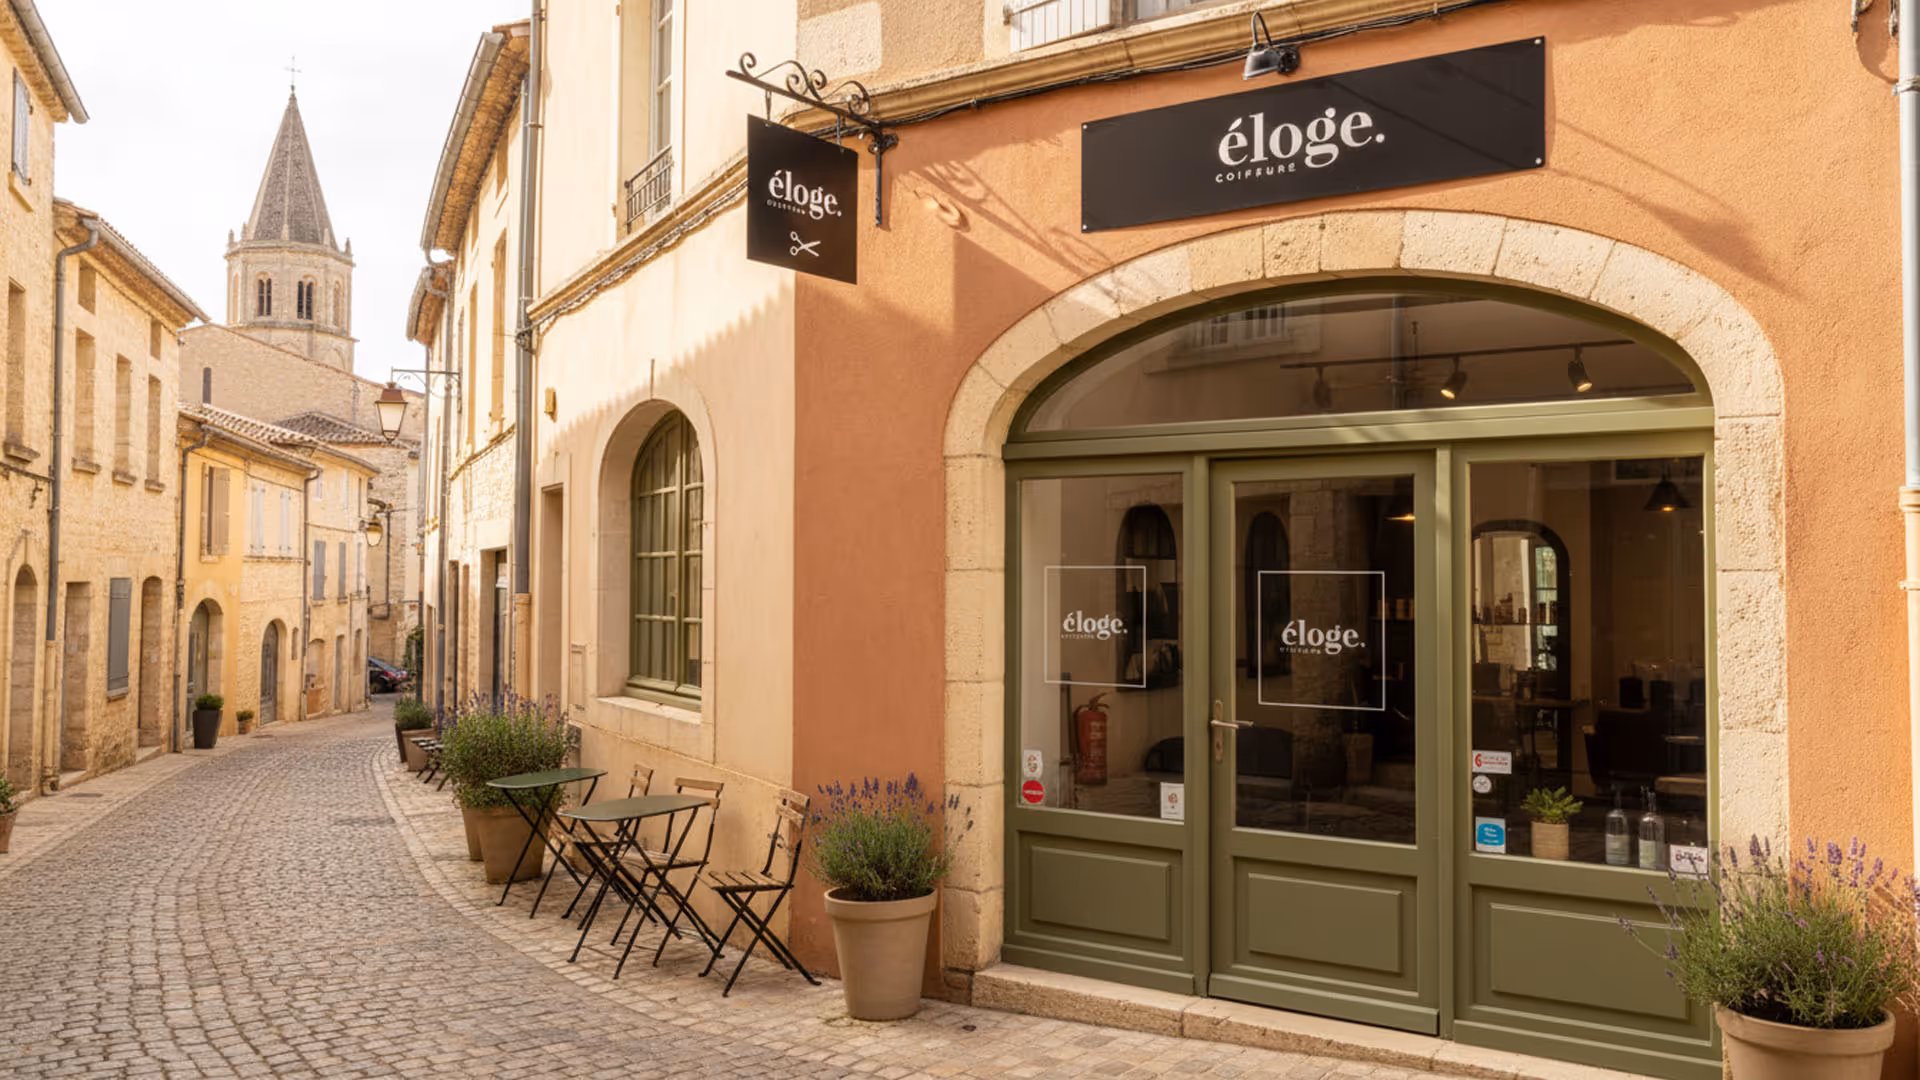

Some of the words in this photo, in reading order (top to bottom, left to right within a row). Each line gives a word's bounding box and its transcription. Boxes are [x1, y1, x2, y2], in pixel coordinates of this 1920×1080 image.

[1218, 107, 1385, 168] éloge.
[1215, 162, 1296, 183] COIFFURE
[768, 169, 842, 220] éloge.
[1063, 610, 1128, 640] éloge.
[1281, 619, 1366, 655] éloge.
